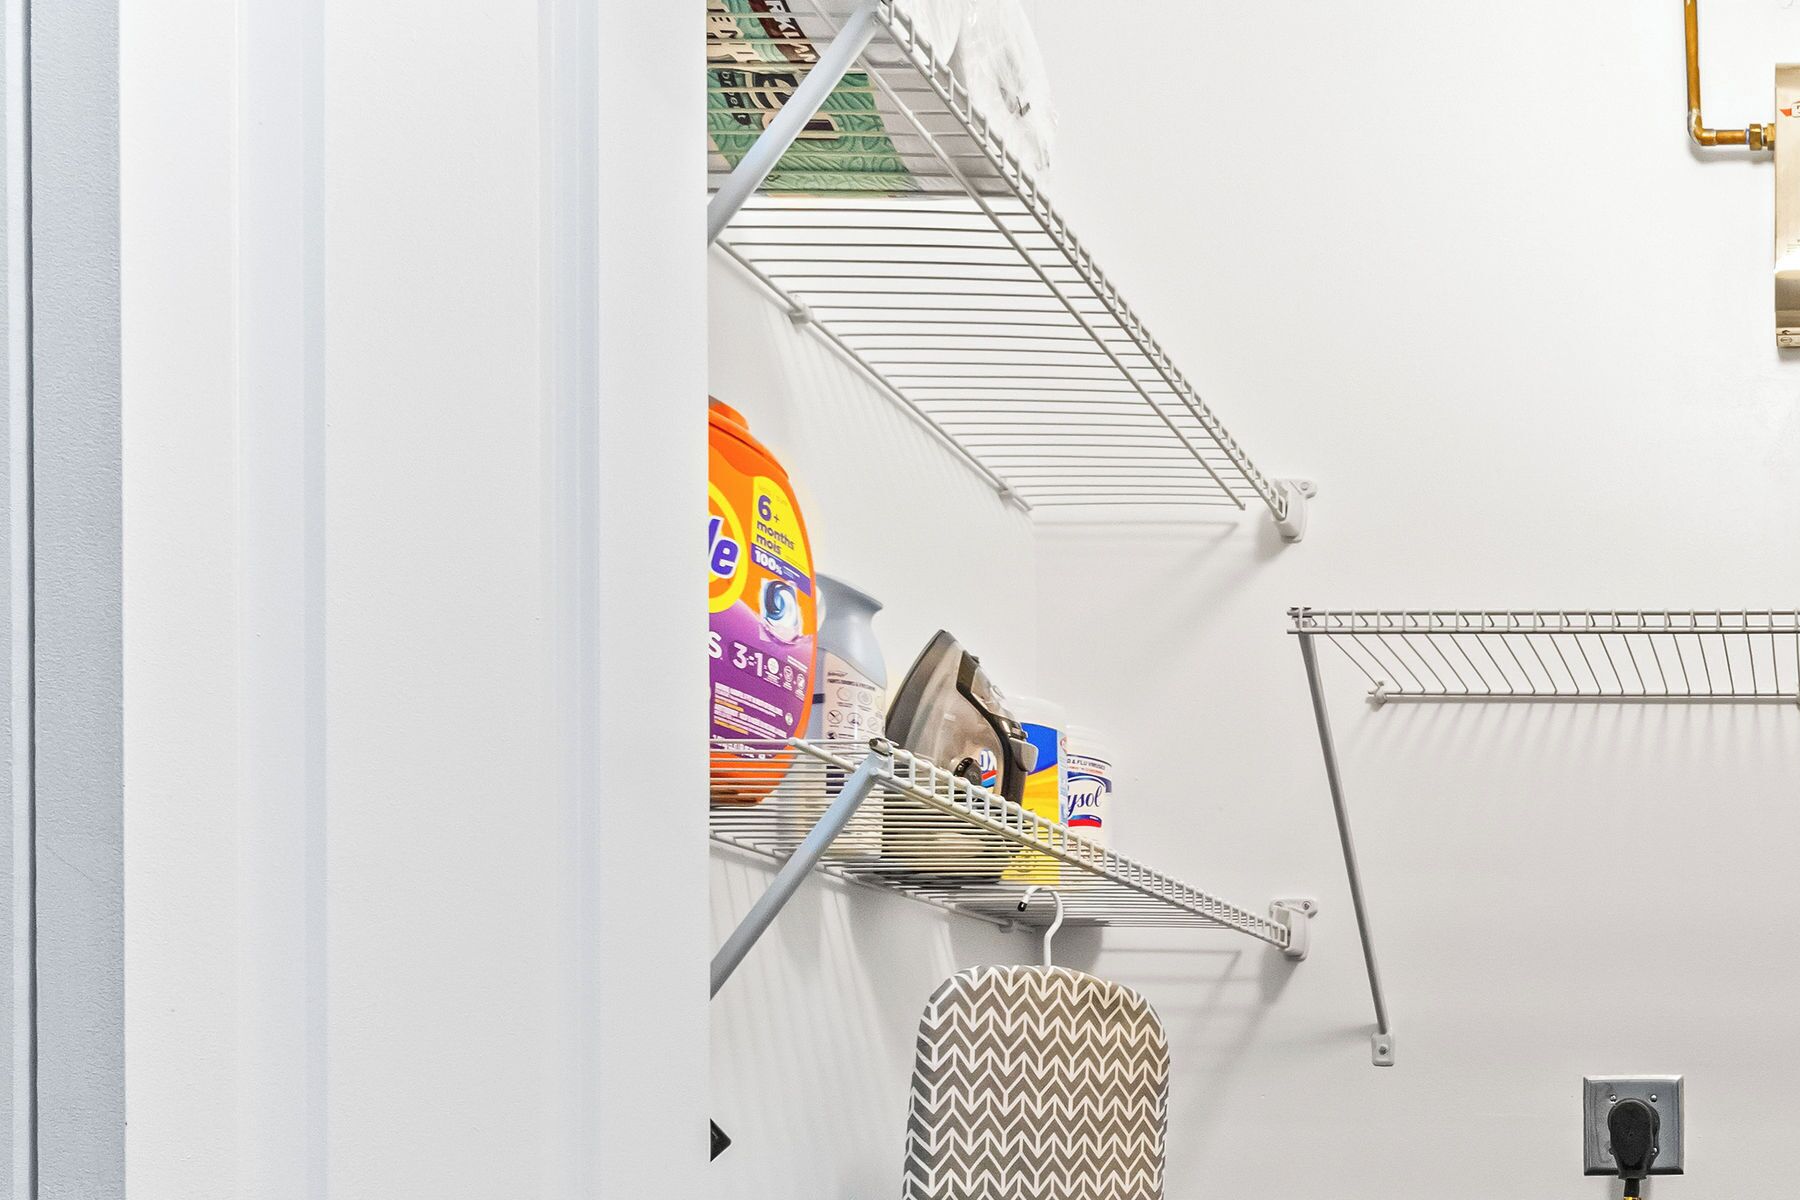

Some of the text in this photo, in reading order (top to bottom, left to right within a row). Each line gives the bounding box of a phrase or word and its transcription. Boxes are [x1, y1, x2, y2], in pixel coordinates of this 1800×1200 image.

[756, 520, 795, 551] months
[756, 533, 782, 556] mois
[754, 549, 783, 576] 100%
[1068, 784, 1103, 818] ysol
